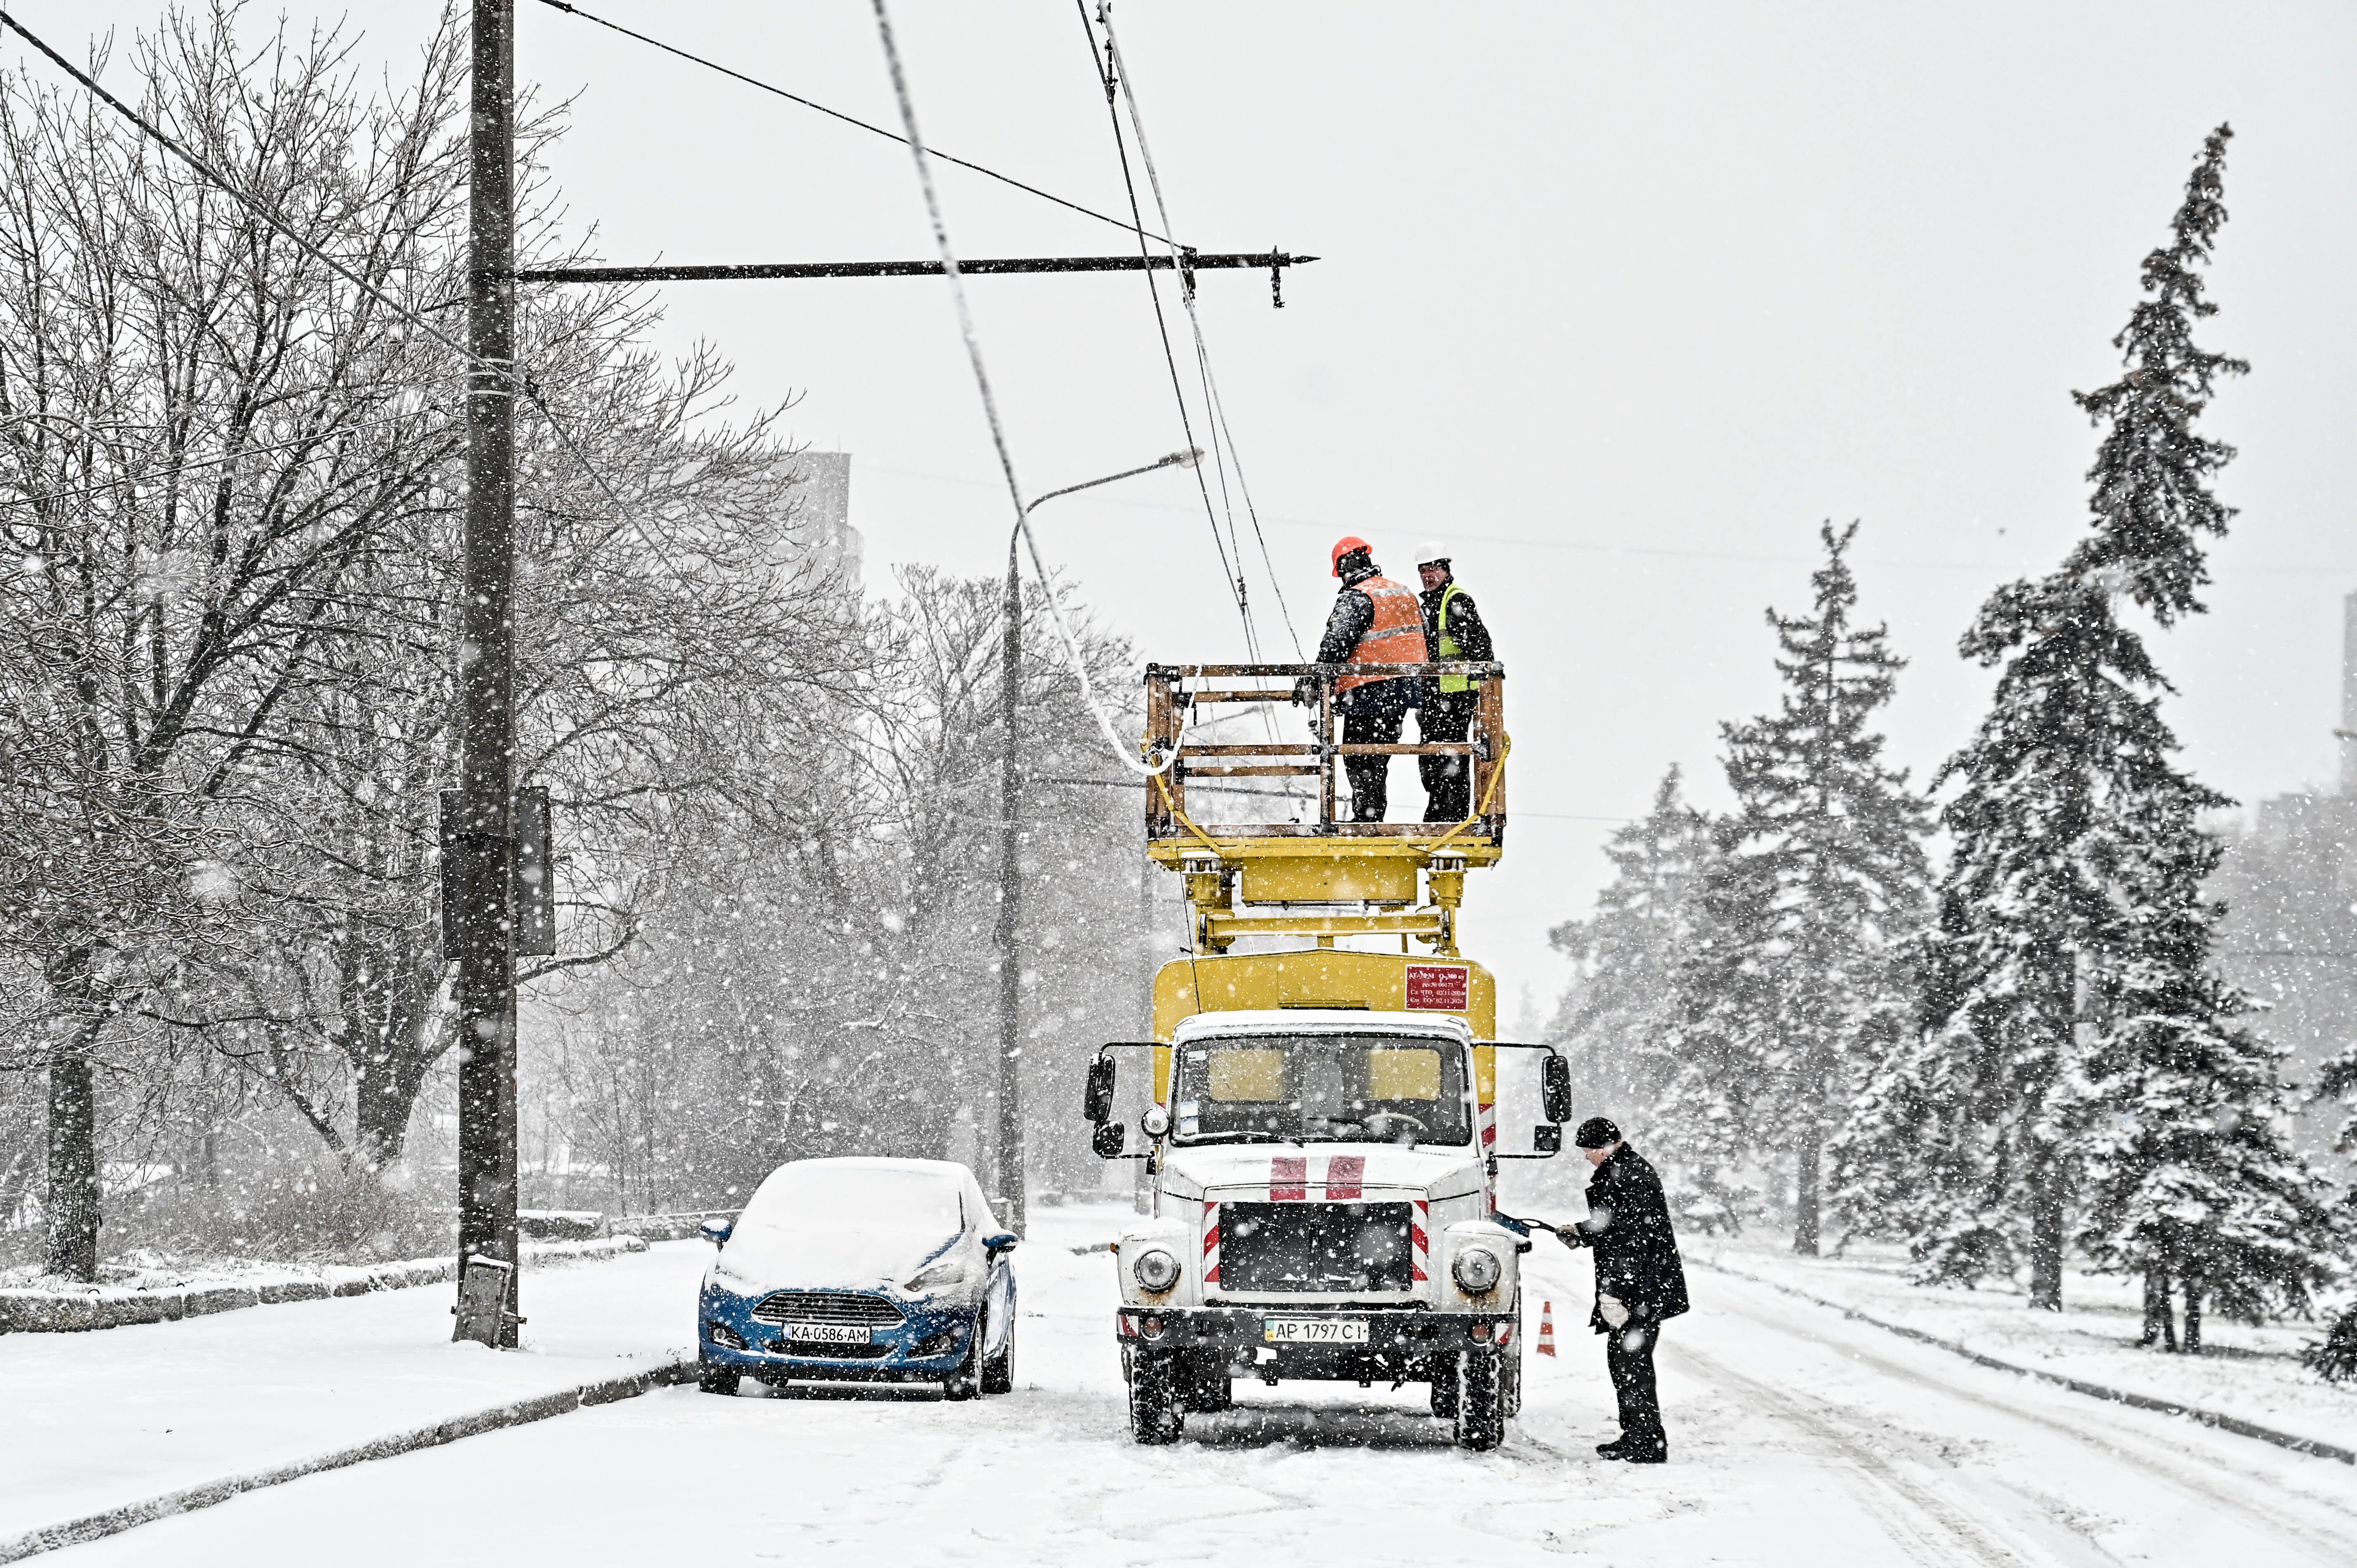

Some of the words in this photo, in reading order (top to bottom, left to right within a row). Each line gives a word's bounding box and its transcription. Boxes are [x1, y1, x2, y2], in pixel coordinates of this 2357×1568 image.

[791, 1326, 810, 1339] KA
[814, 1327, 843, 1340] 0586
[847, 1329, 866, 1342] AM
[1276, 1324, 1298, 1338] AP
[1303, 1324, 1338, 1339] 1797
